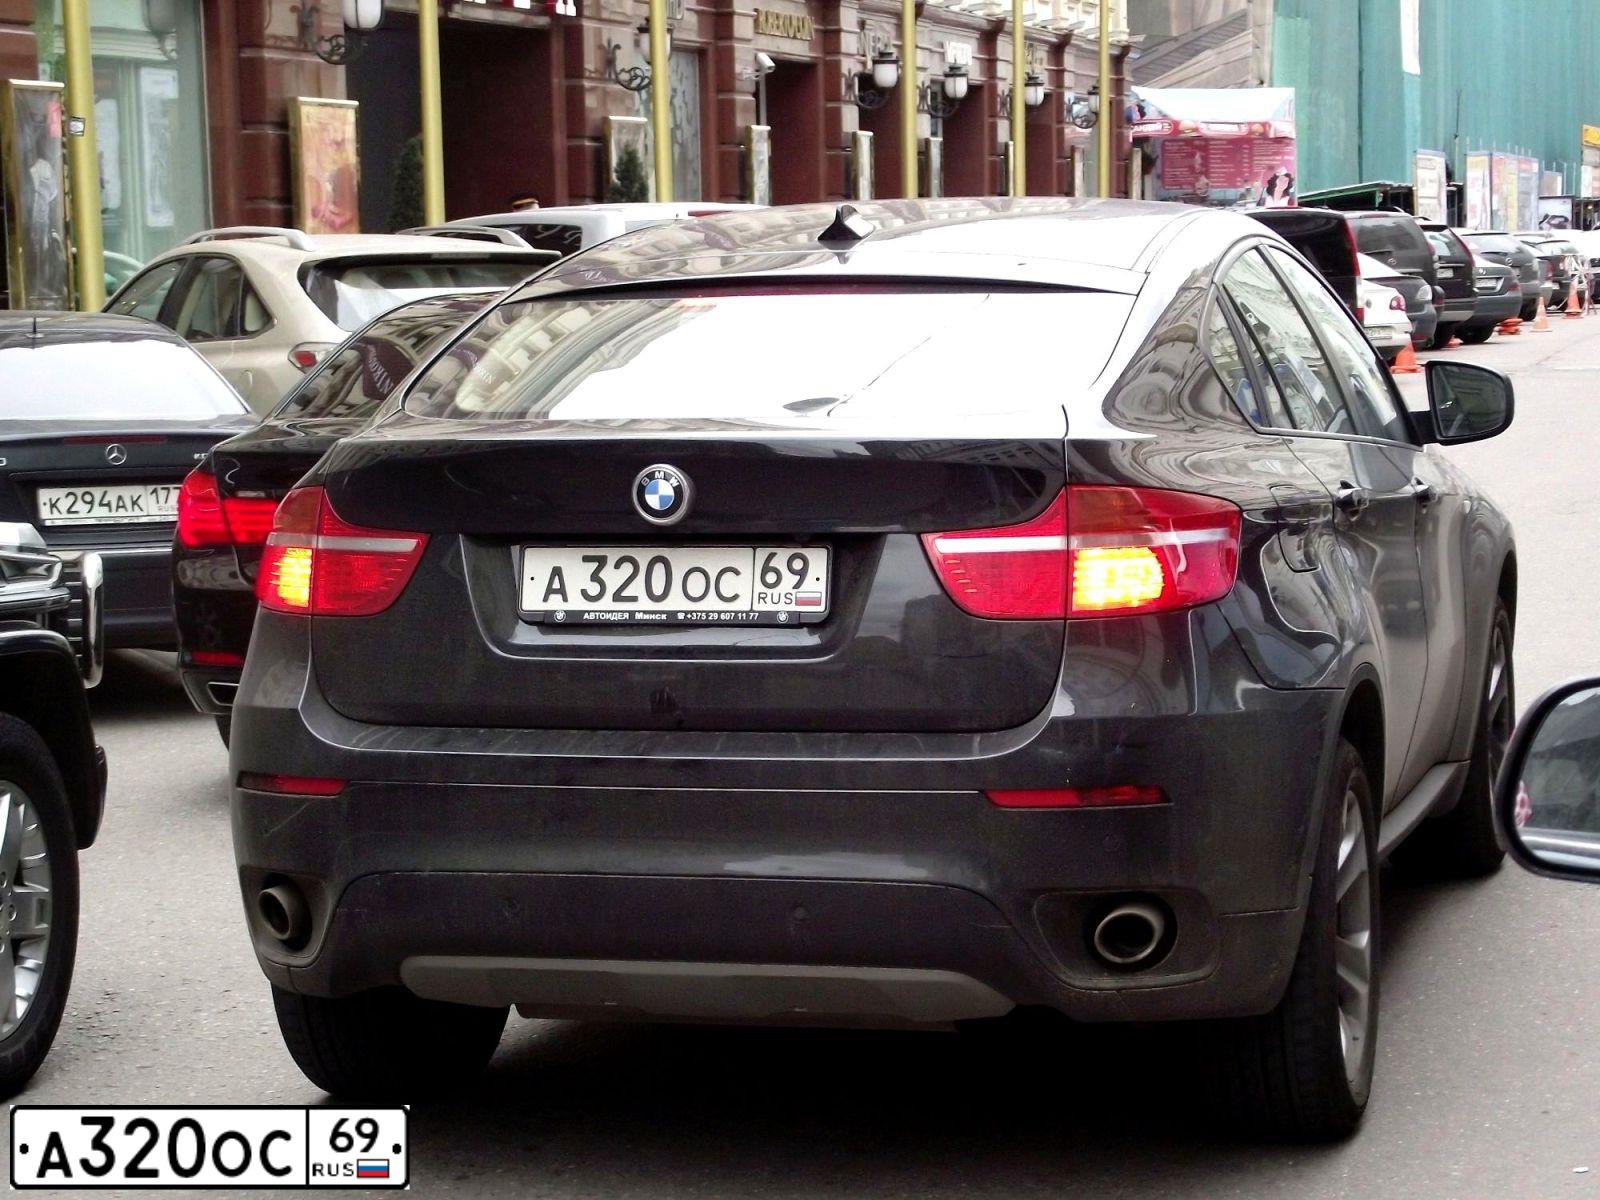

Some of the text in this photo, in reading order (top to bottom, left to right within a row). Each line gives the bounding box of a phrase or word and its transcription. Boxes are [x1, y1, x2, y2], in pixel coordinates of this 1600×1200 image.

[641, 471, 679, 487] BMW
[759, 551, 810, 590] 69
[757, 591, 794, 605] RUS
[583, 611, 630, 621] АВТОИДЕЯ
[635, 611, 667, 620] Минск
[708, 612, 719, 620] 29
[720, 612, 736, 621] 607
[737, 612, 747, 620] 11
[748, 612, 759, 621] 77
